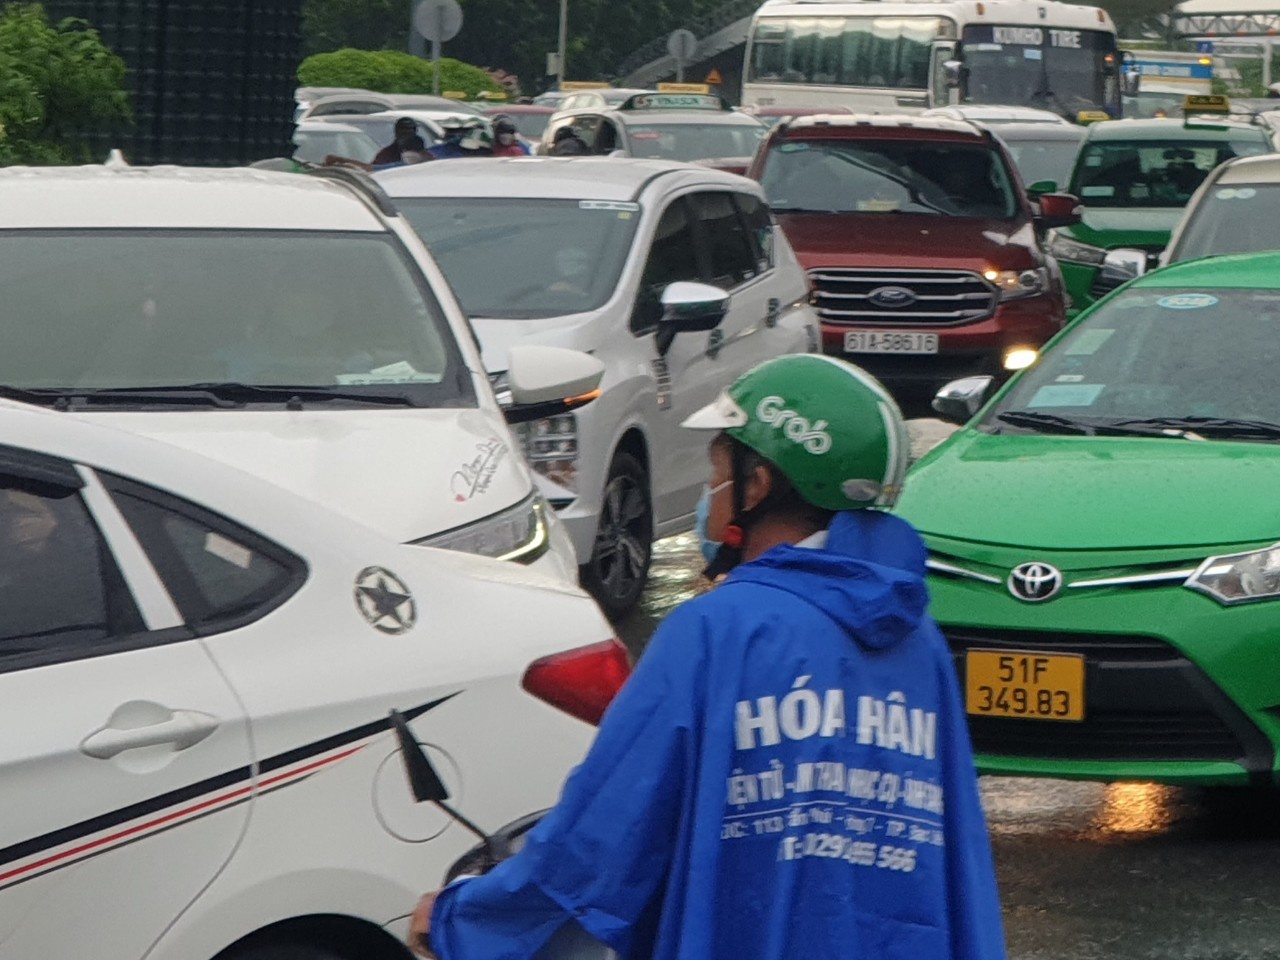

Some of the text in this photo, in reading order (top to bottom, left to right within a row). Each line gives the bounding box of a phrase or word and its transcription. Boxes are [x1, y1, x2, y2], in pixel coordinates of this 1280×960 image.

[755, 395, 833, 455] Grab
[998, 655, 1050, 685] 51F
[976, 685, 1071, 717] 349.83
